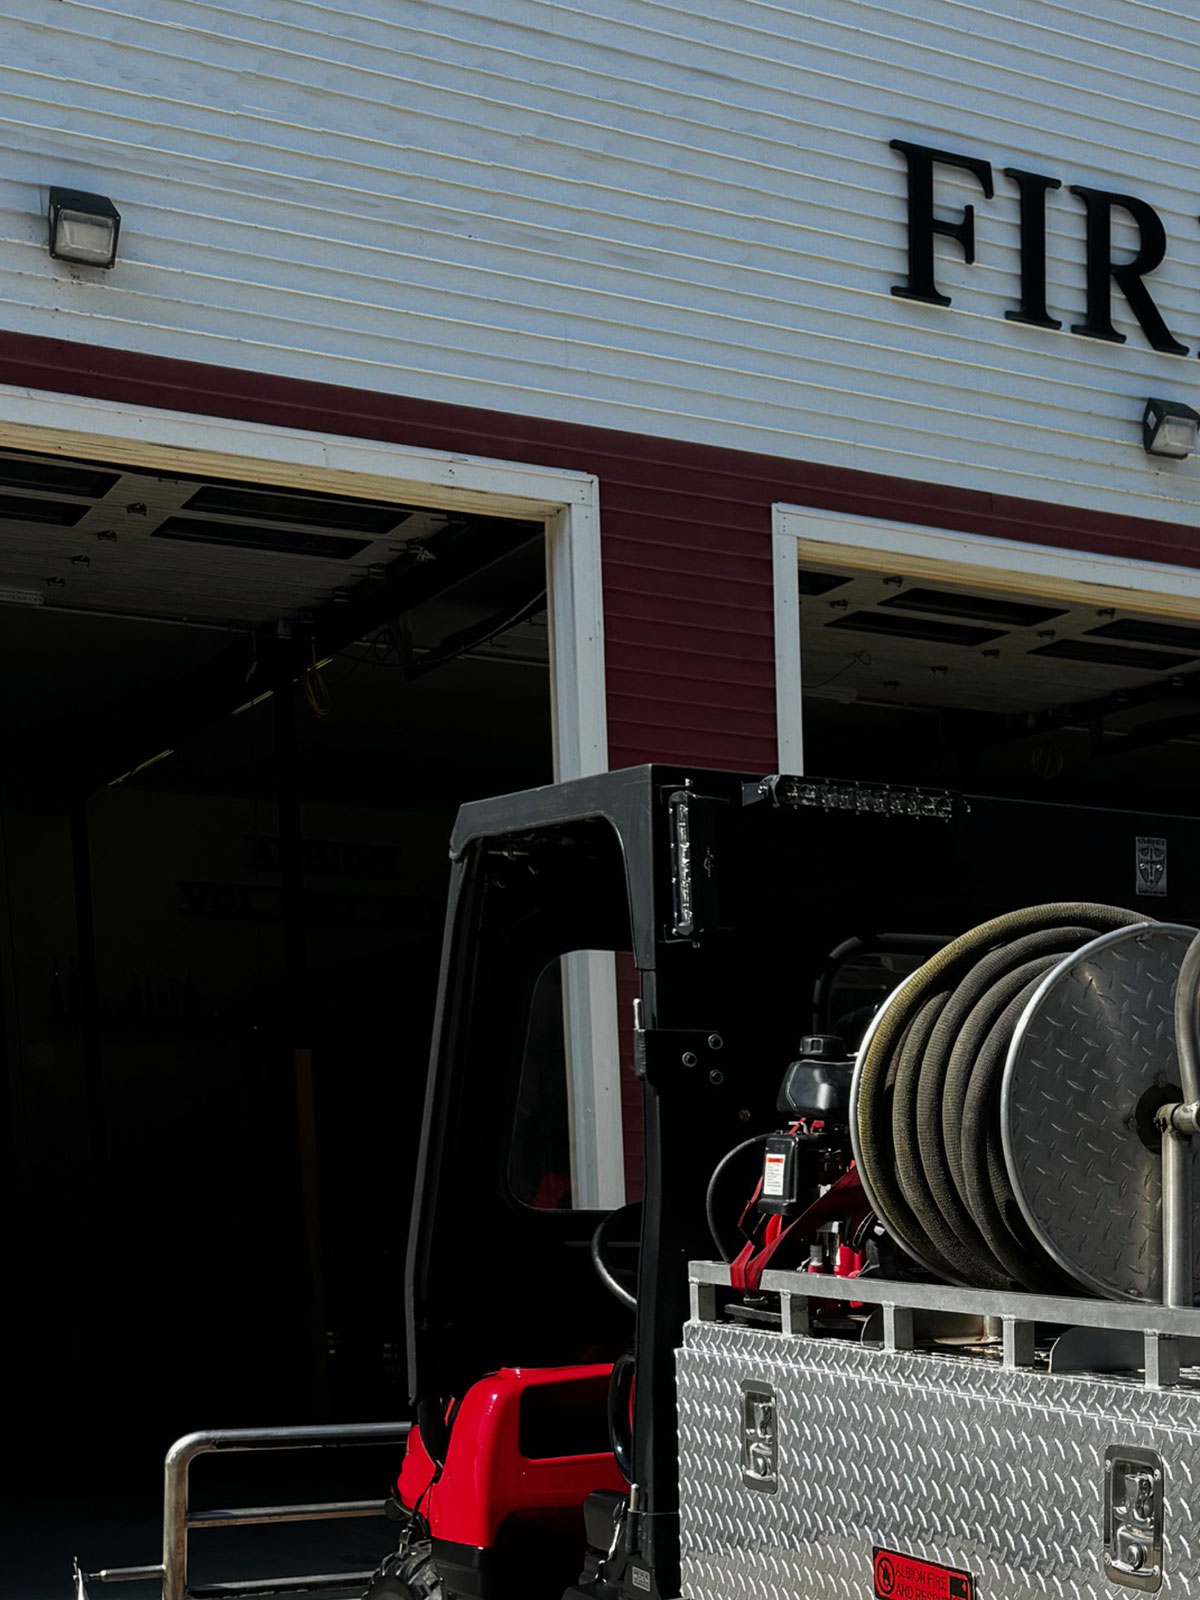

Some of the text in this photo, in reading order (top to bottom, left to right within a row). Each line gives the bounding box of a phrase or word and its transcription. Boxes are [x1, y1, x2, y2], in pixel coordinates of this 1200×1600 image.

[896, 1563, 948, 1591] ALBION FIRE
[896, 1583, 913, 1599] AND
